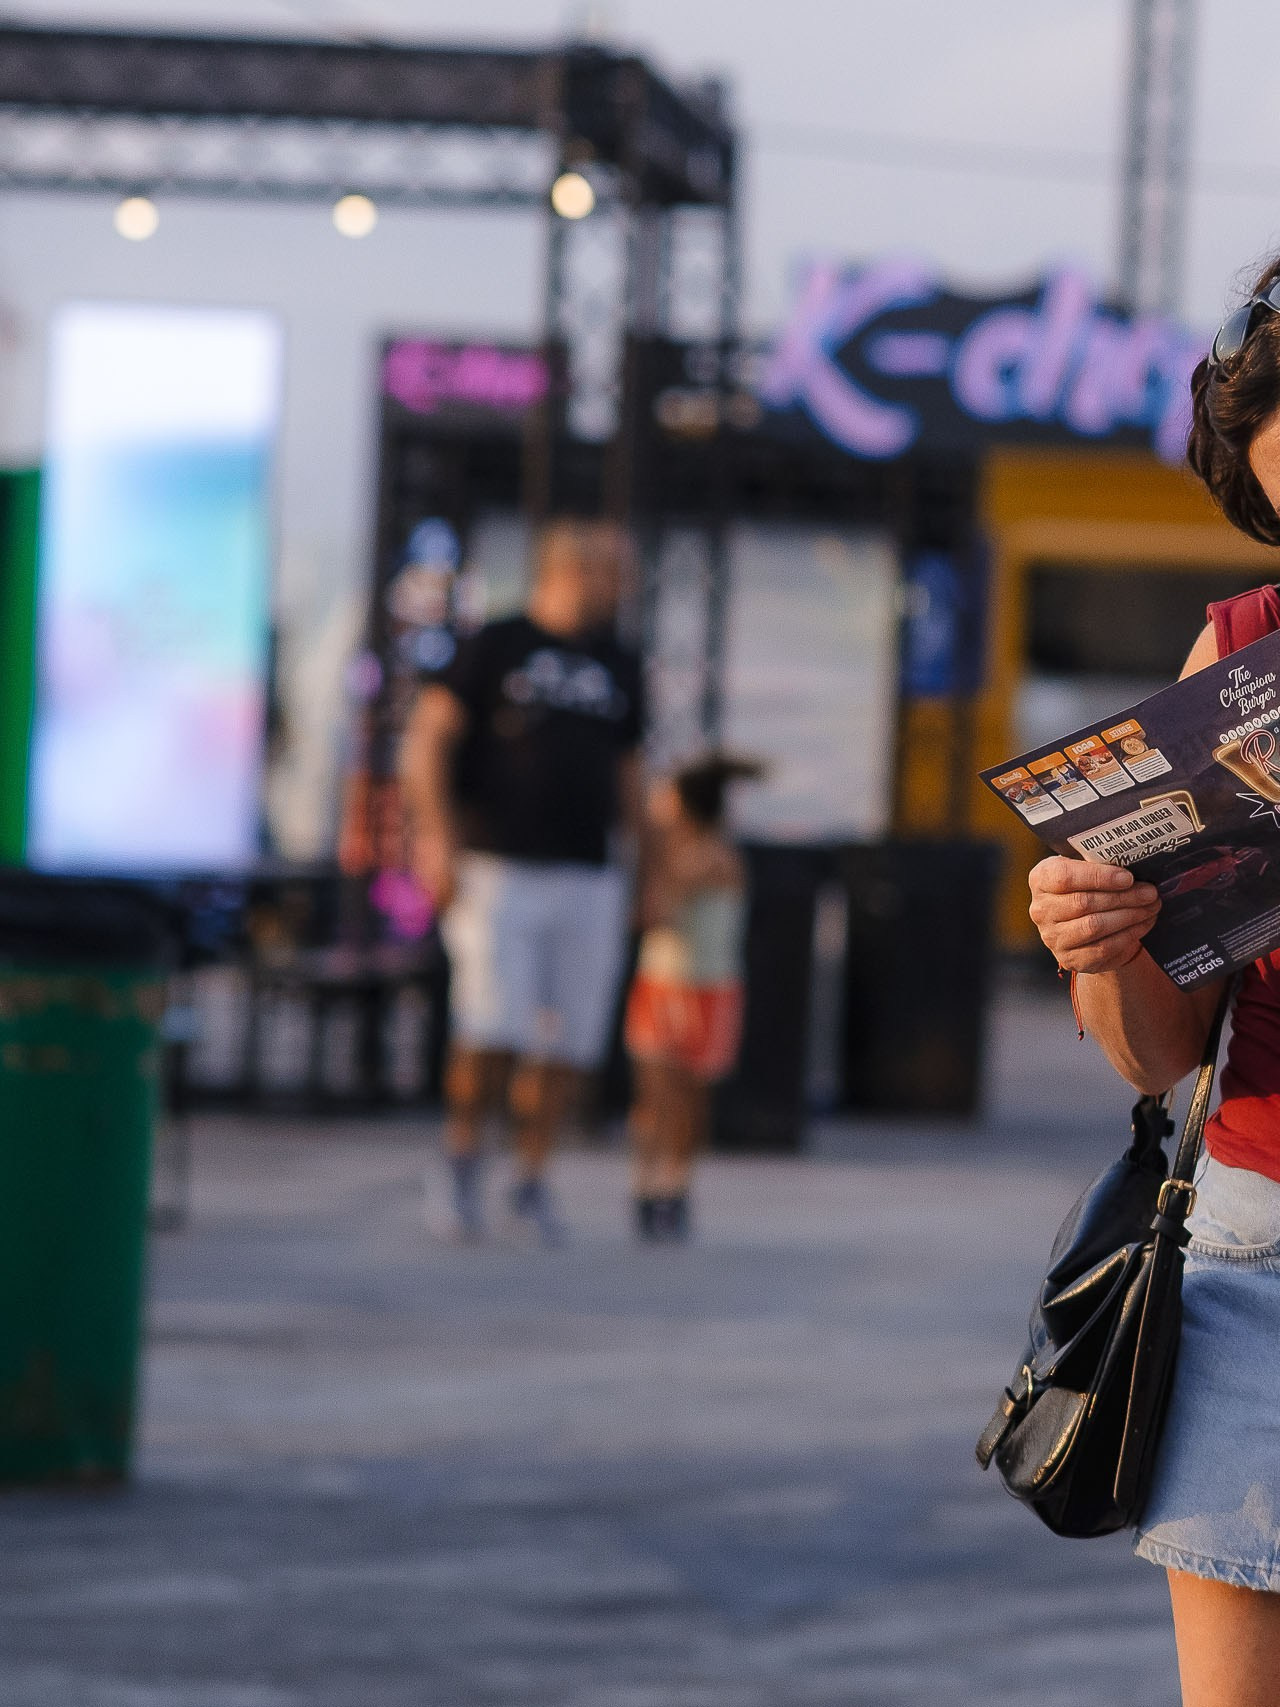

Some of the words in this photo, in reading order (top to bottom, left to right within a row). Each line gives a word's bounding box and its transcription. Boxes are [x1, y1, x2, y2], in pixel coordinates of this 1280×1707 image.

[1220, 672, 1276, 707] Champions
[1228, 665, 1251, 688] The
[1238, 687, 1276, 716] Burger
[1080, 837, 1104, 851] VOTA
[1101, 828, 1115, 842] LA
[1112, 819, 1143, 837] MEJOR
[1139, 807, 1173, 826] BURGER
[1097, 851, 1107, 860] Y
[1136, 826, 1165, 844] GANAR
[1162, 821, 1178, 833] UN
[1109, 837, 1190, 866] Mustang
[1173, 969, 1199, 985] Uber
[1197, 957, 1224, 974] Eats
